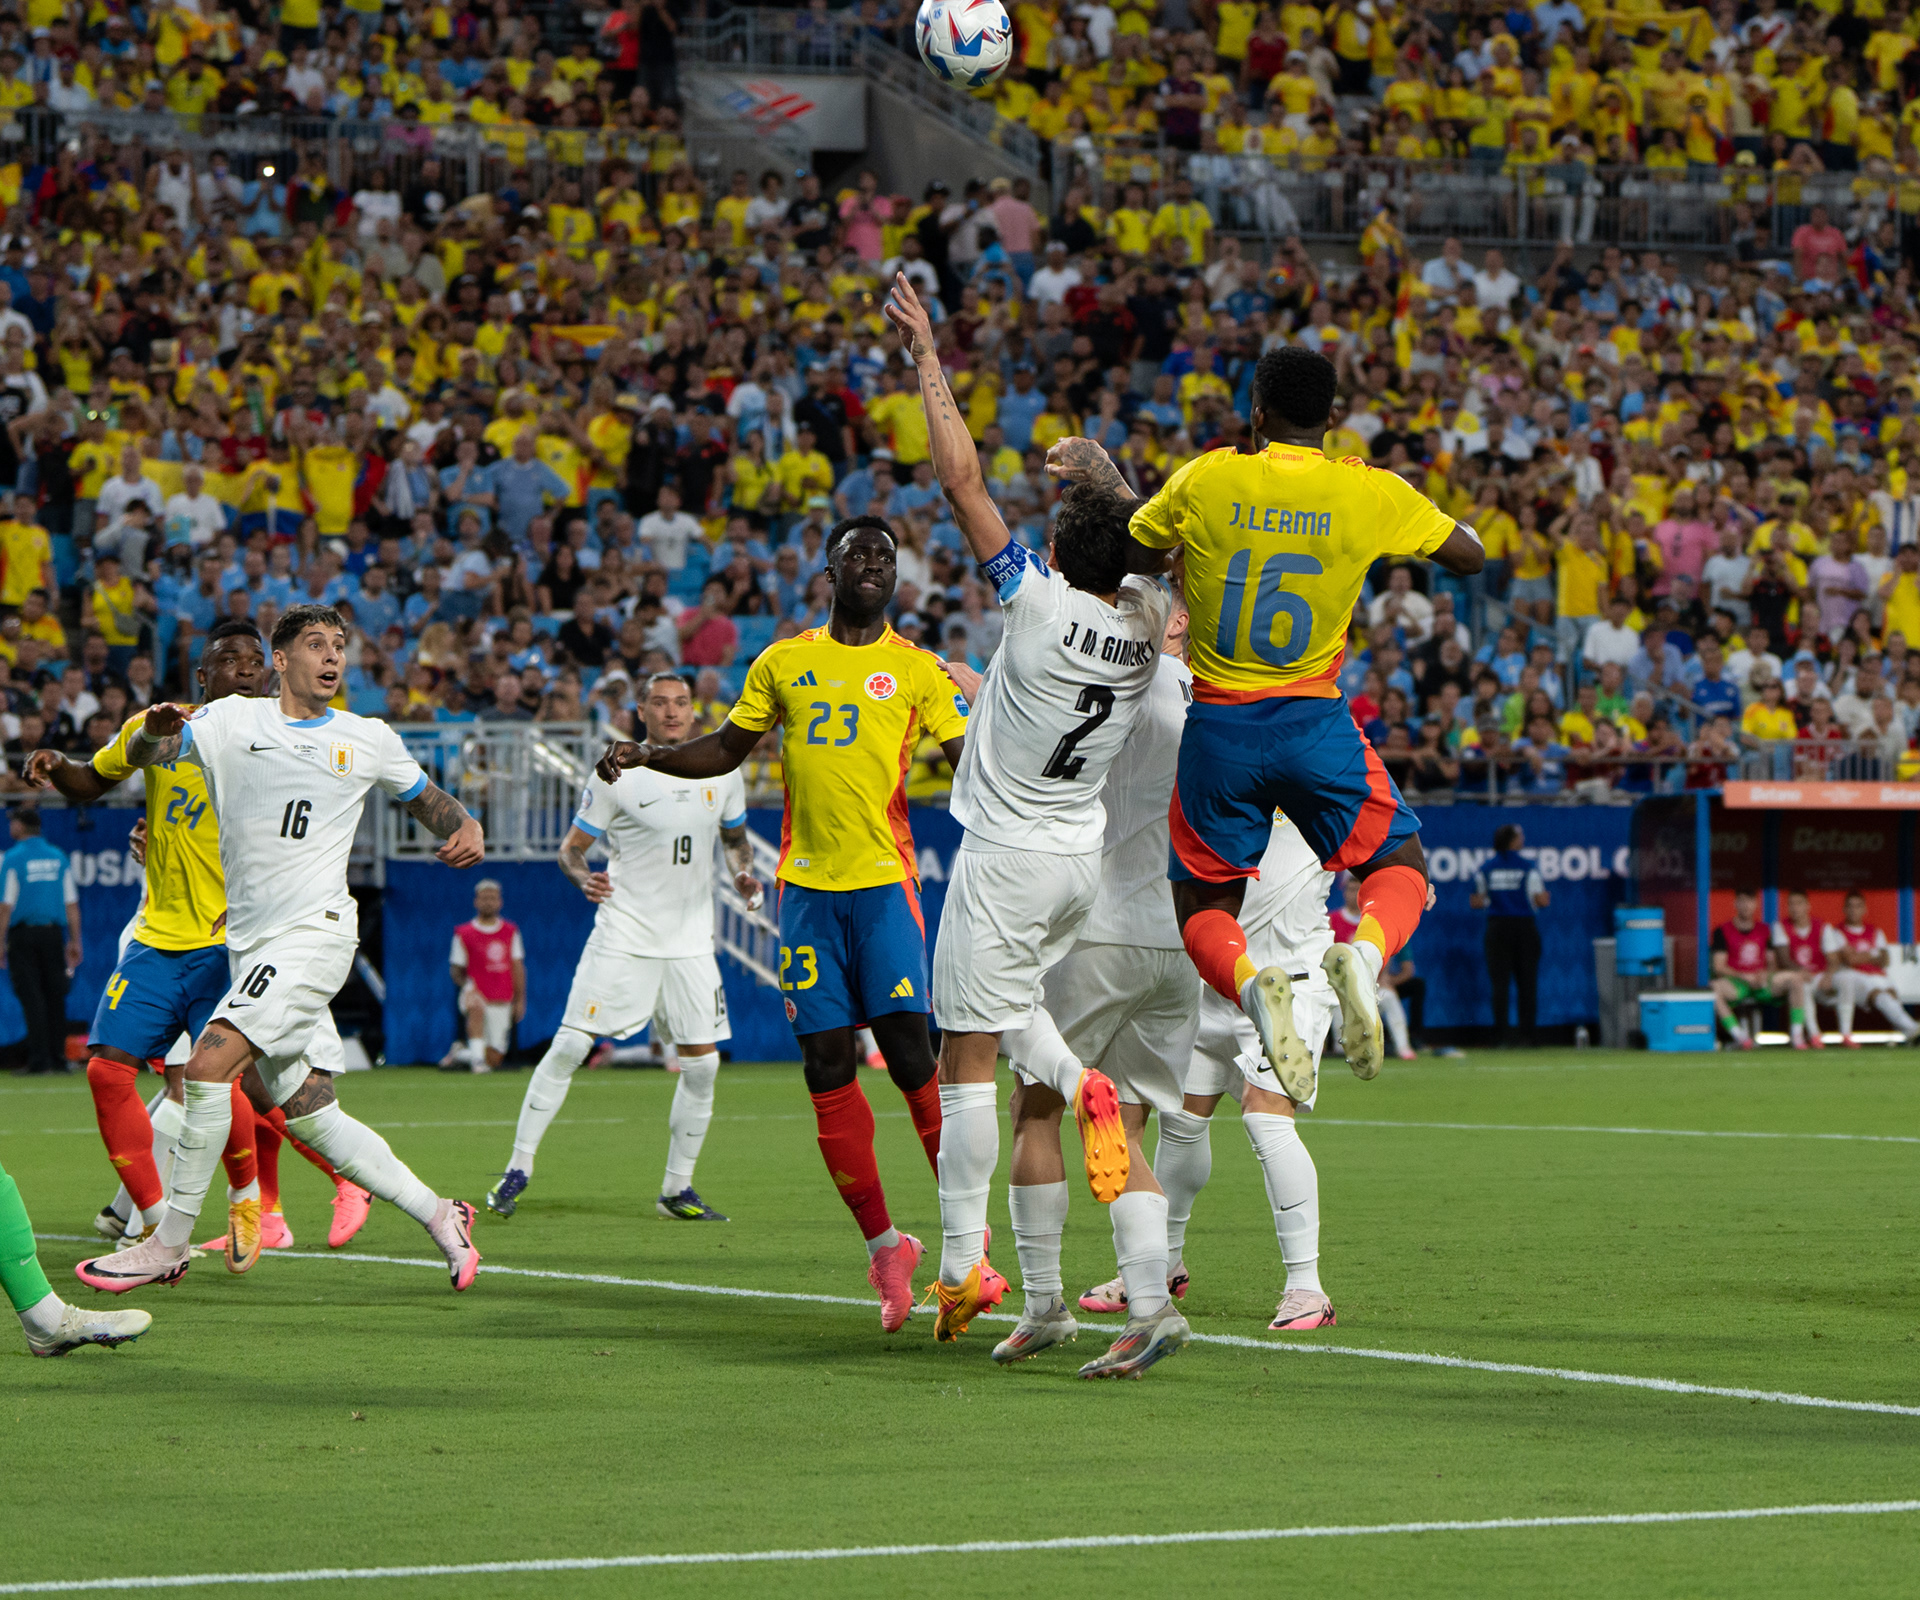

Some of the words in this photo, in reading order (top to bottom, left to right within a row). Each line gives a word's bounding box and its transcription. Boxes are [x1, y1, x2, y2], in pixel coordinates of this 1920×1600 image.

[1268, 451, 1304, 462] COLOMBIA
[1229, 502, 1331, 536] J.LERMA
[1215, 548, 1324, 667] 16
[807, 701, 860, 747] 23
[1041, 684, 1116, 780] 2
[165, 786, 207, 831] 24
[280, 799, 312, 840] 16
[70, 849, 144, 887] USA
[673, 835, 692, 865] 19
[239, 963, 277, 998] 16
[779, 945, 818, 990] 23
